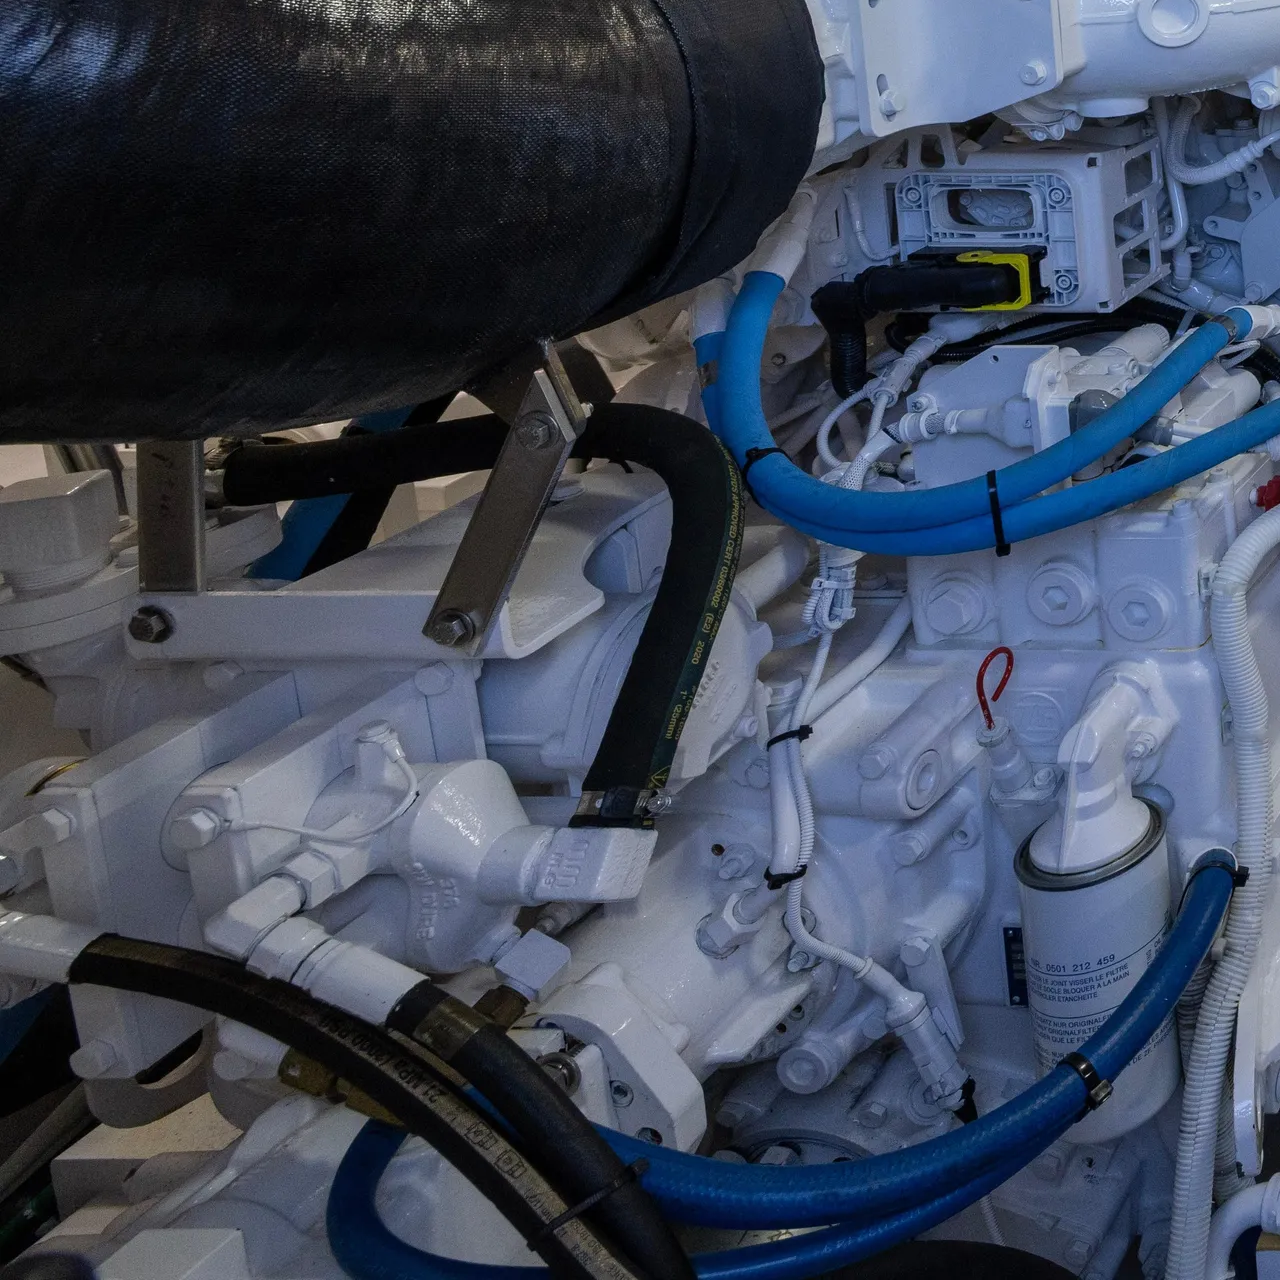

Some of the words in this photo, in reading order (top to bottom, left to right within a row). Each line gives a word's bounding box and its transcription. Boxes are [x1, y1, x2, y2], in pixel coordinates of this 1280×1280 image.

[723, 542, 735, 566] CERT
[702, 613, 714, 634] (E2)
[692, 641, 705, 665] 2020
[665, 704, 682, 740] (25mm)
[1046, 964, 1066, 973] 0501
[1072, 962, 1091, 972] 212
[1096, 954, 1115, 966] 459
[1069, 976, 1094, 986] VISSER
[1095, 974, 1104, 982] LE
[1105, 963, 1129, 977] FILTRE
[1063, 984, 1096, 994] BLOQUER
[1102, 979, 1112, 987] LA
[1112, 970, 1130, 982] MAIN
[1053, 1020, 1067, 1028] NUR
[1067, 1036, 1075, 1044] LE
